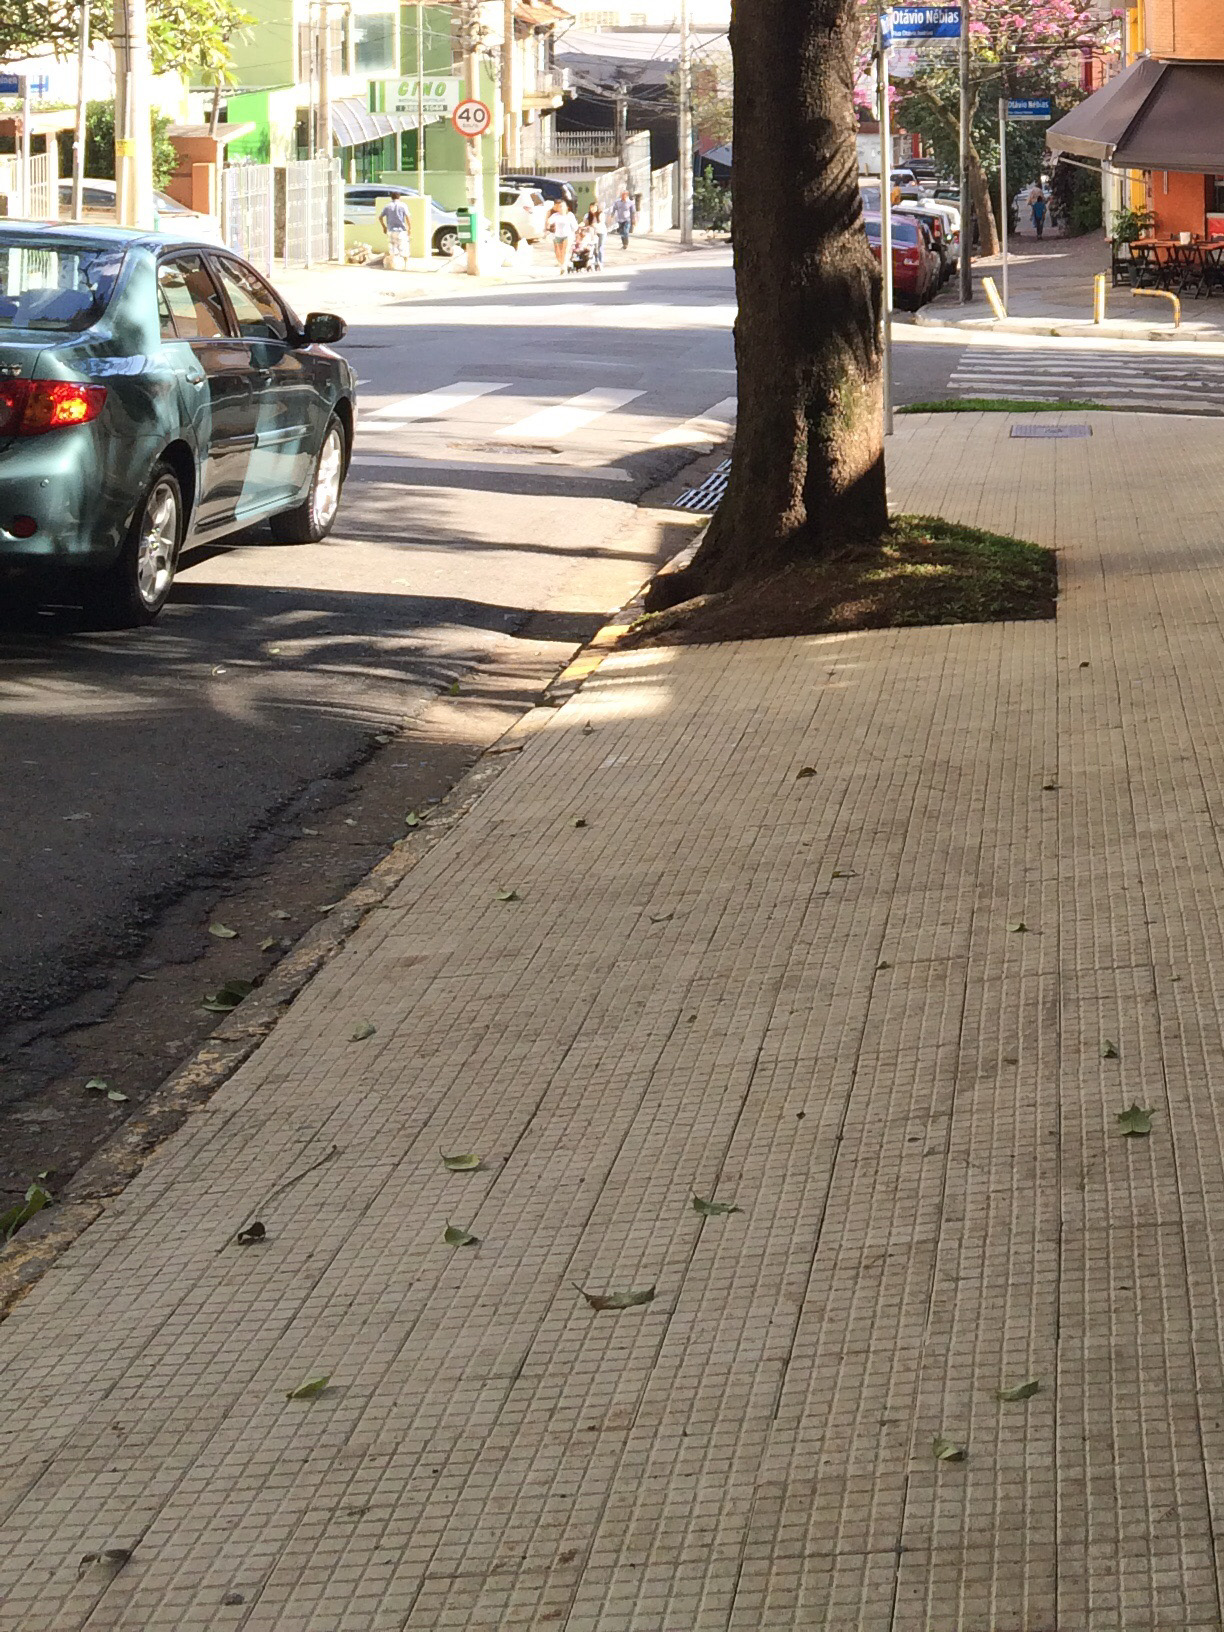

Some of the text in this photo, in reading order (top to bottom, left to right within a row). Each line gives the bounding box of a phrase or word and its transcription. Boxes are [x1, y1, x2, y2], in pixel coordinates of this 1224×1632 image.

[893, 9, 924, 25] Otávio
[925, 8, 959, 24] Nébias
[458, 108, 485, 123] 40
